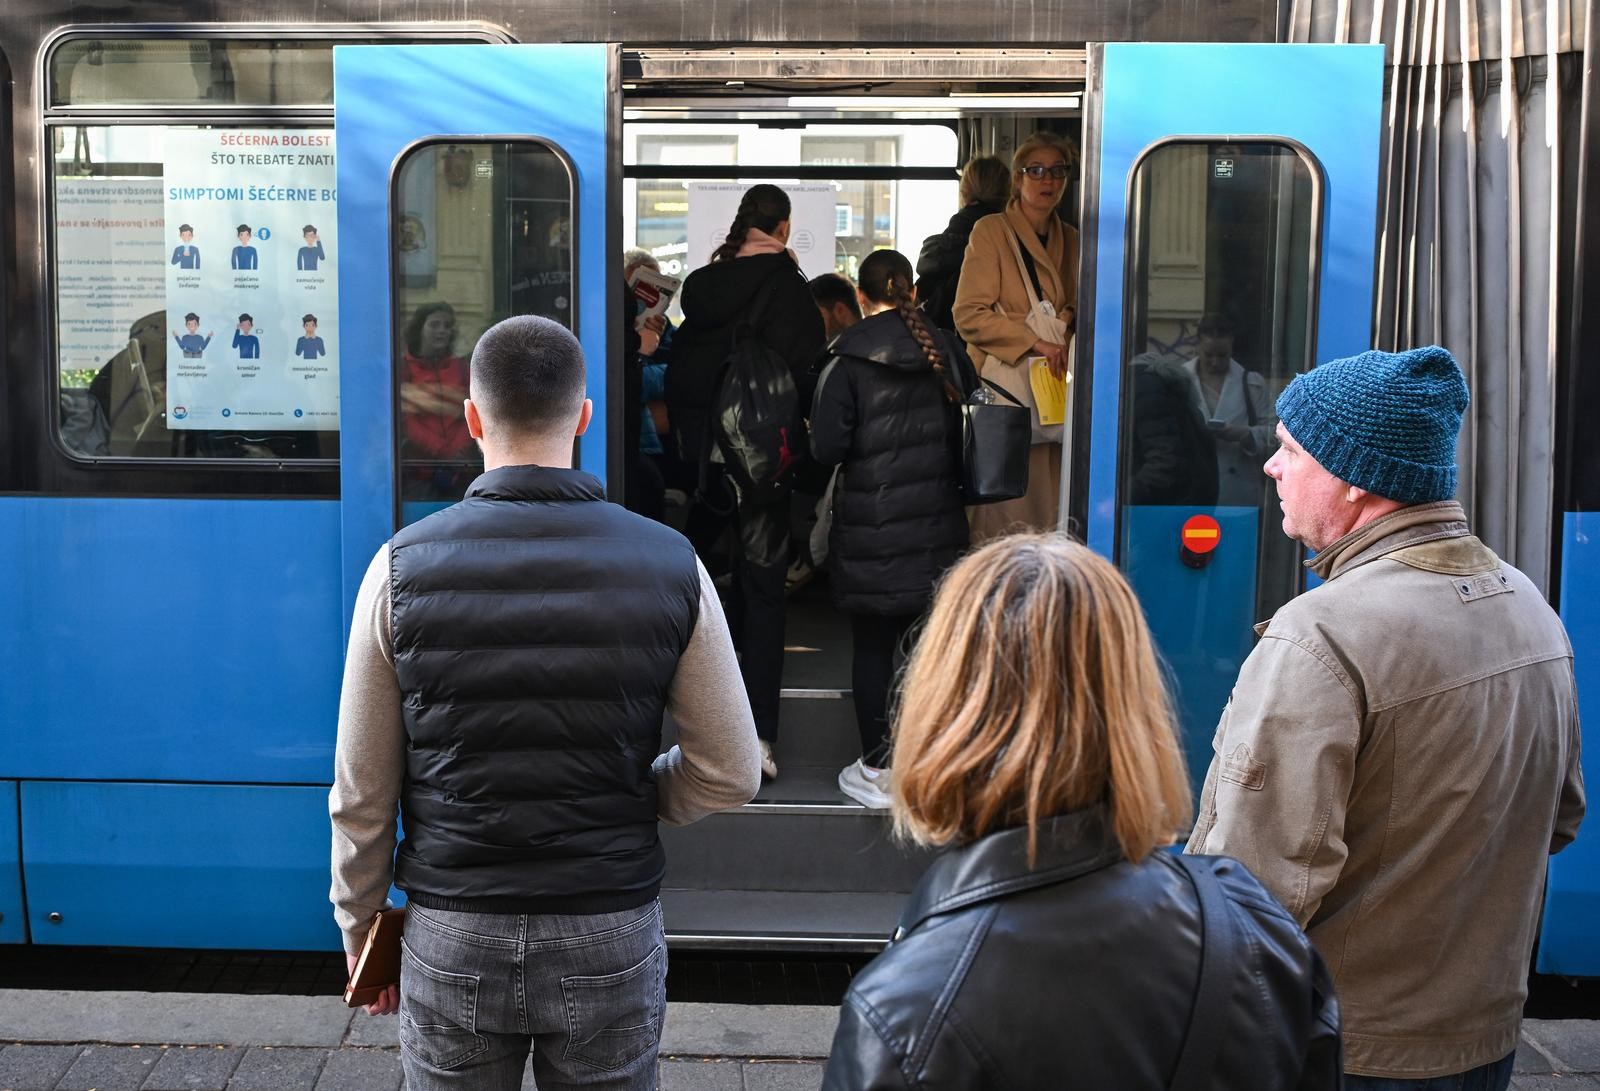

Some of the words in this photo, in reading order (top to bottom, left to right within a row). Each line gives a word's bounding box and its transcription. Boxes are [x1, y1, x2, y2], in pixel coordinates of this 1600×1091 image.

[220, 132, 279, 146] ŠEĆERNA
[282, 135, 331, 146] BOLEST
[211, 151, 236, 165] ŠTO
[239, 154, 295, 165] TREBATE
[298, 154, 334, 166] ZNATI
[169, 187, 244, 201] SIMPTOMI
[248, 185, 317, 201] ŠEĆERNE
